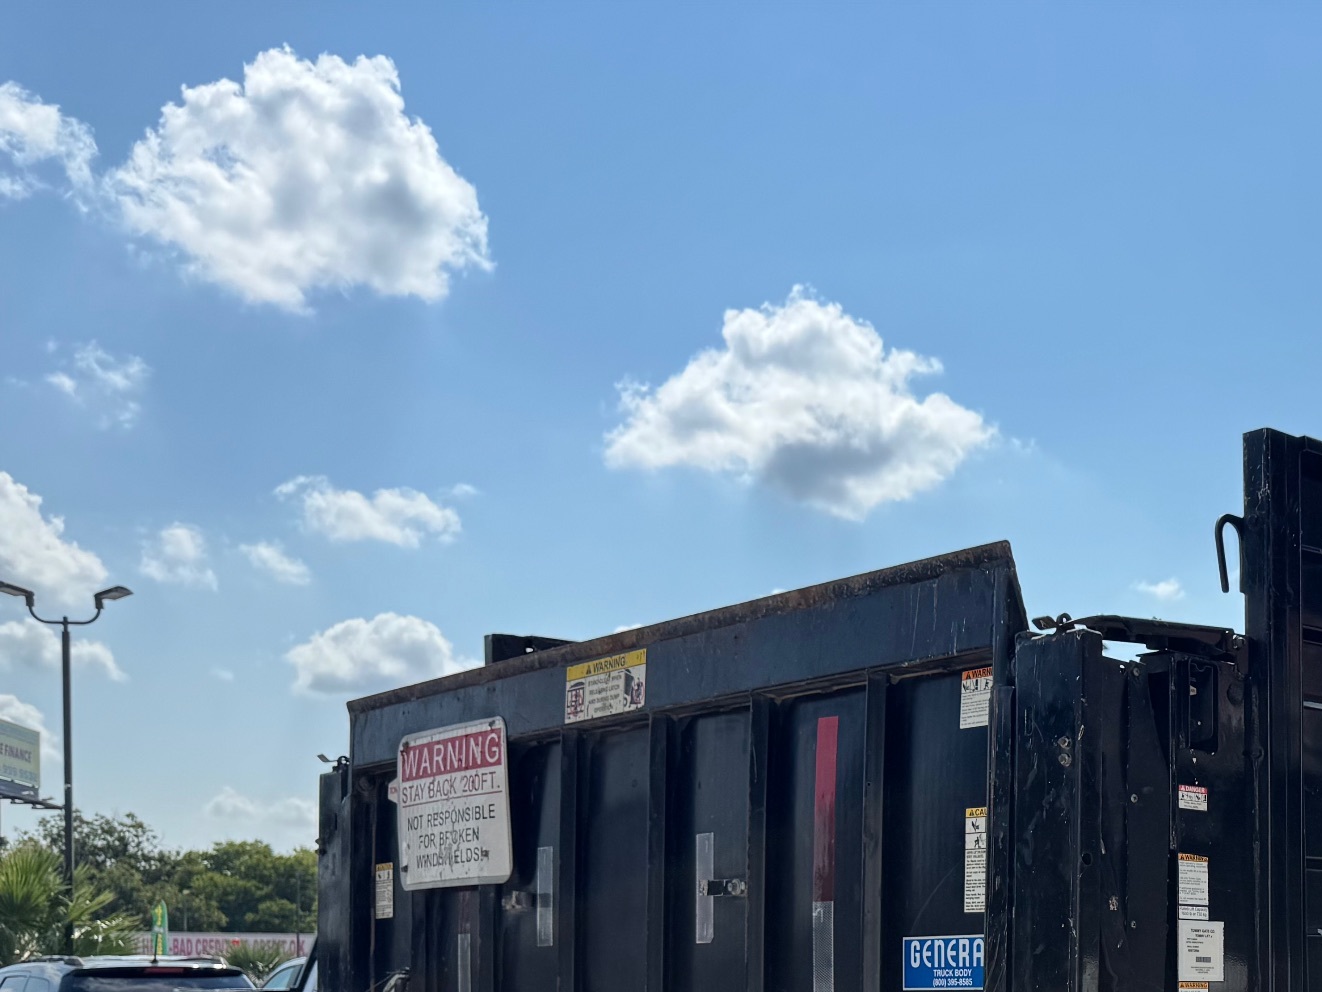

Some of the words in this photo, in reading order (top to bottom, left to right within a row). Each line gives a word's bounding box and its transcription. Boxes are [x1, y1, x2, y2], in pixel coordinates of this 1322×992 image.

[593, 656, 626, 675] WARNING
[404, 732, 499, 779] WARNING
[402, 783, 429, 803] STAY
[428, 776, 457, 799] BACK
[407, 815, 423, 831] NOT
[427, 804, 496, 828] RESPONSIBLE
[419, 832, 436, 849] FOR
[933, 968, 953, 977] TRUCK
[954, 968, 973, 977] BODY
[932, 978, 947, 988] (800)
